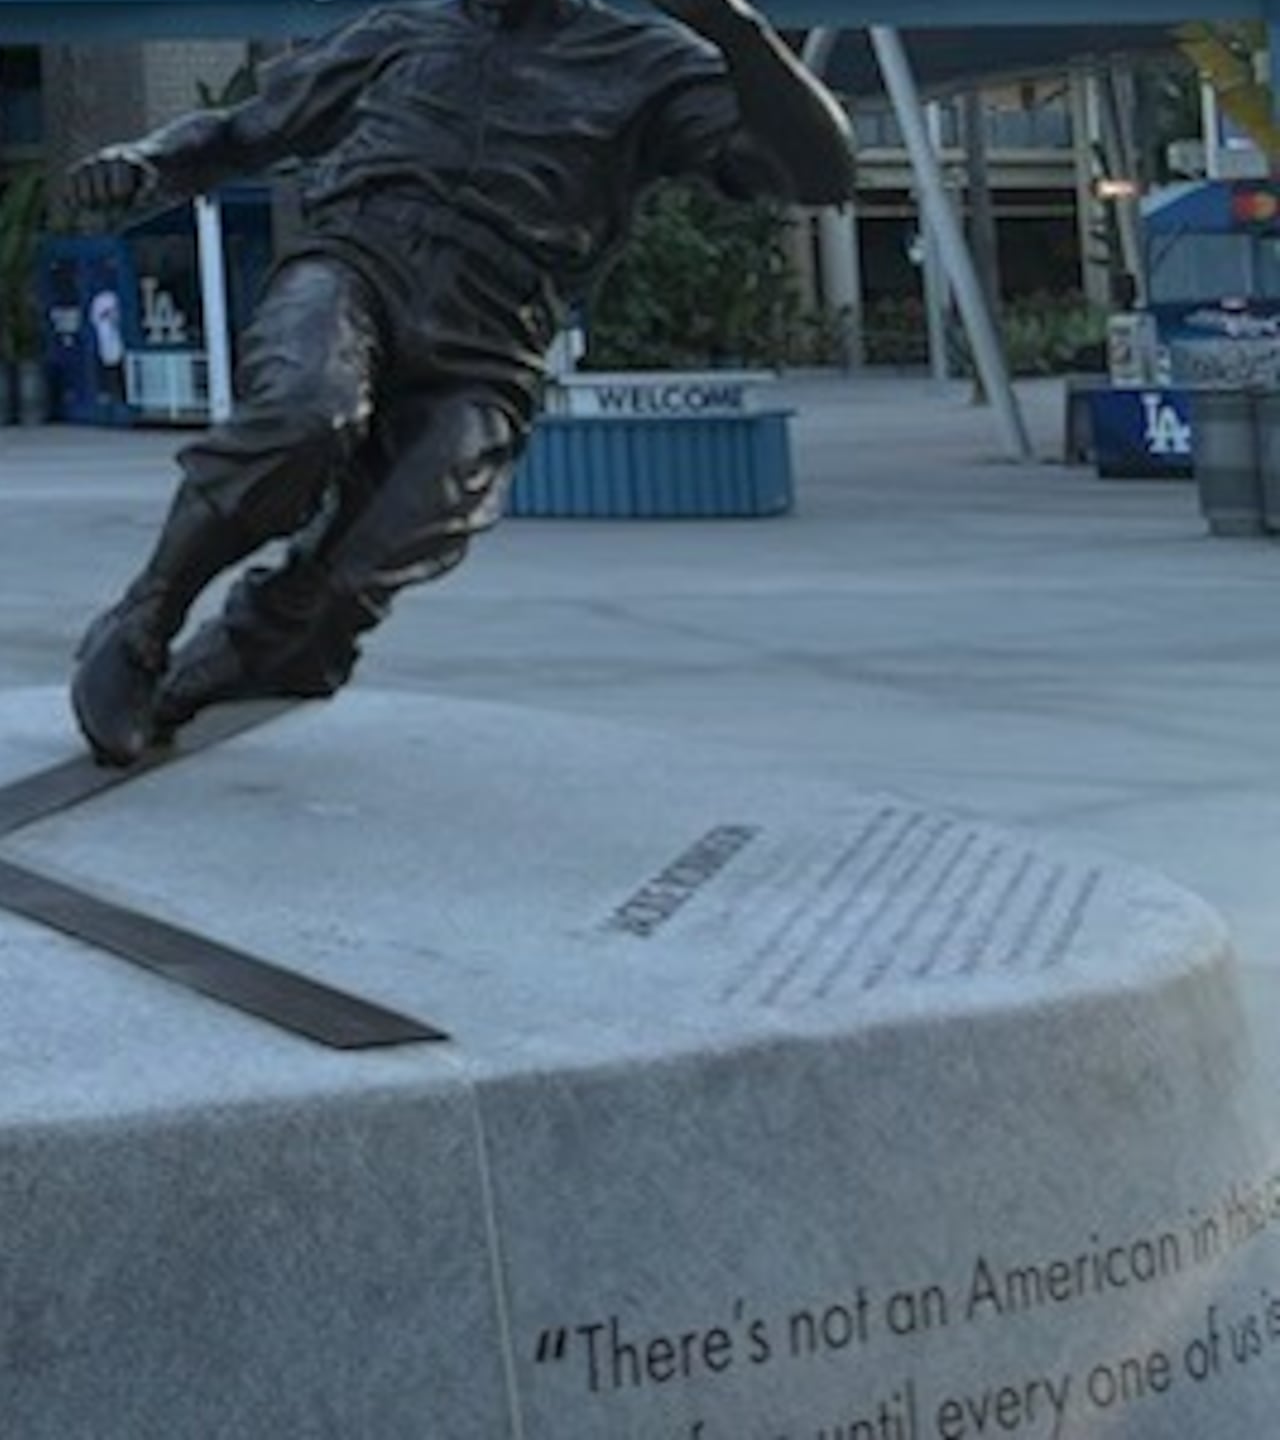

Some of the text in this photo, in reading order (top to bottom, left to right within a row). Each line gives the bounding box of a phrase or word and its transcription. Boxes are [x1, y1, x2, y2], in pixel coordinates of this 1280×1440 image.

[596, 384, 744, 412] WELCOME
[1142, 391, 1193, 454] LA
[790, 1285, 869, 1357] not
[886, 1284, 949, 1336] an
[966, 1231, 1181, 1320] American
[1187, 1207, 1220, 1264] in
[937, 1372, 1072, 1440] every
[1087, 1350, 1172, 1410] one
[1183, 1303, 1220, 1382] of
